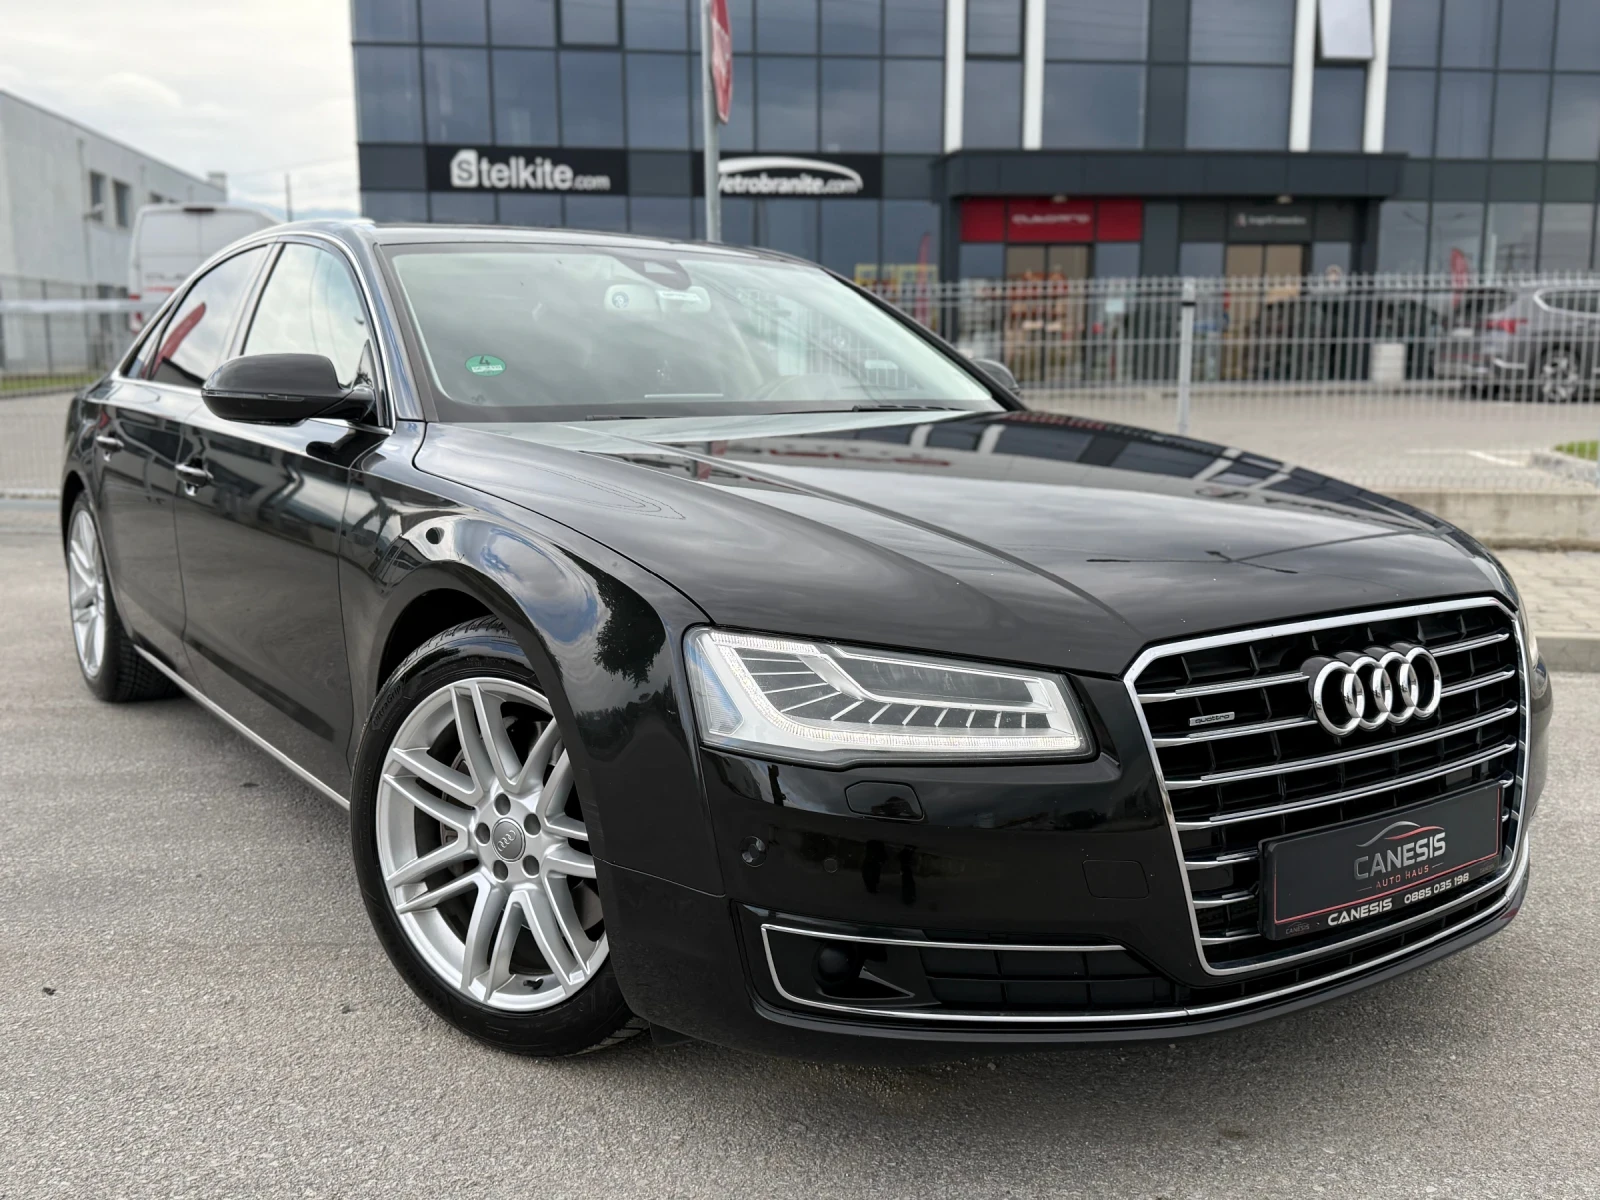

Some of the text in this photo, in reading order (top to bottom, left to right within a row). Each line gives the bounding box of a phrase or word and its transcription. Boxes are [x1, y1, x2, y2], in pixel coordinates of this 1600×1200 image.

[450, 149, 611, 190] Stelkite.com
[1194, 714, 1230, 724] quattro
[1353, 831, 1446, 881] CANESIS
[1375, 864, 1430, 889] AUTO HAUS
[1327, 872, 1469, 926] CANESIS 0885 035 198
